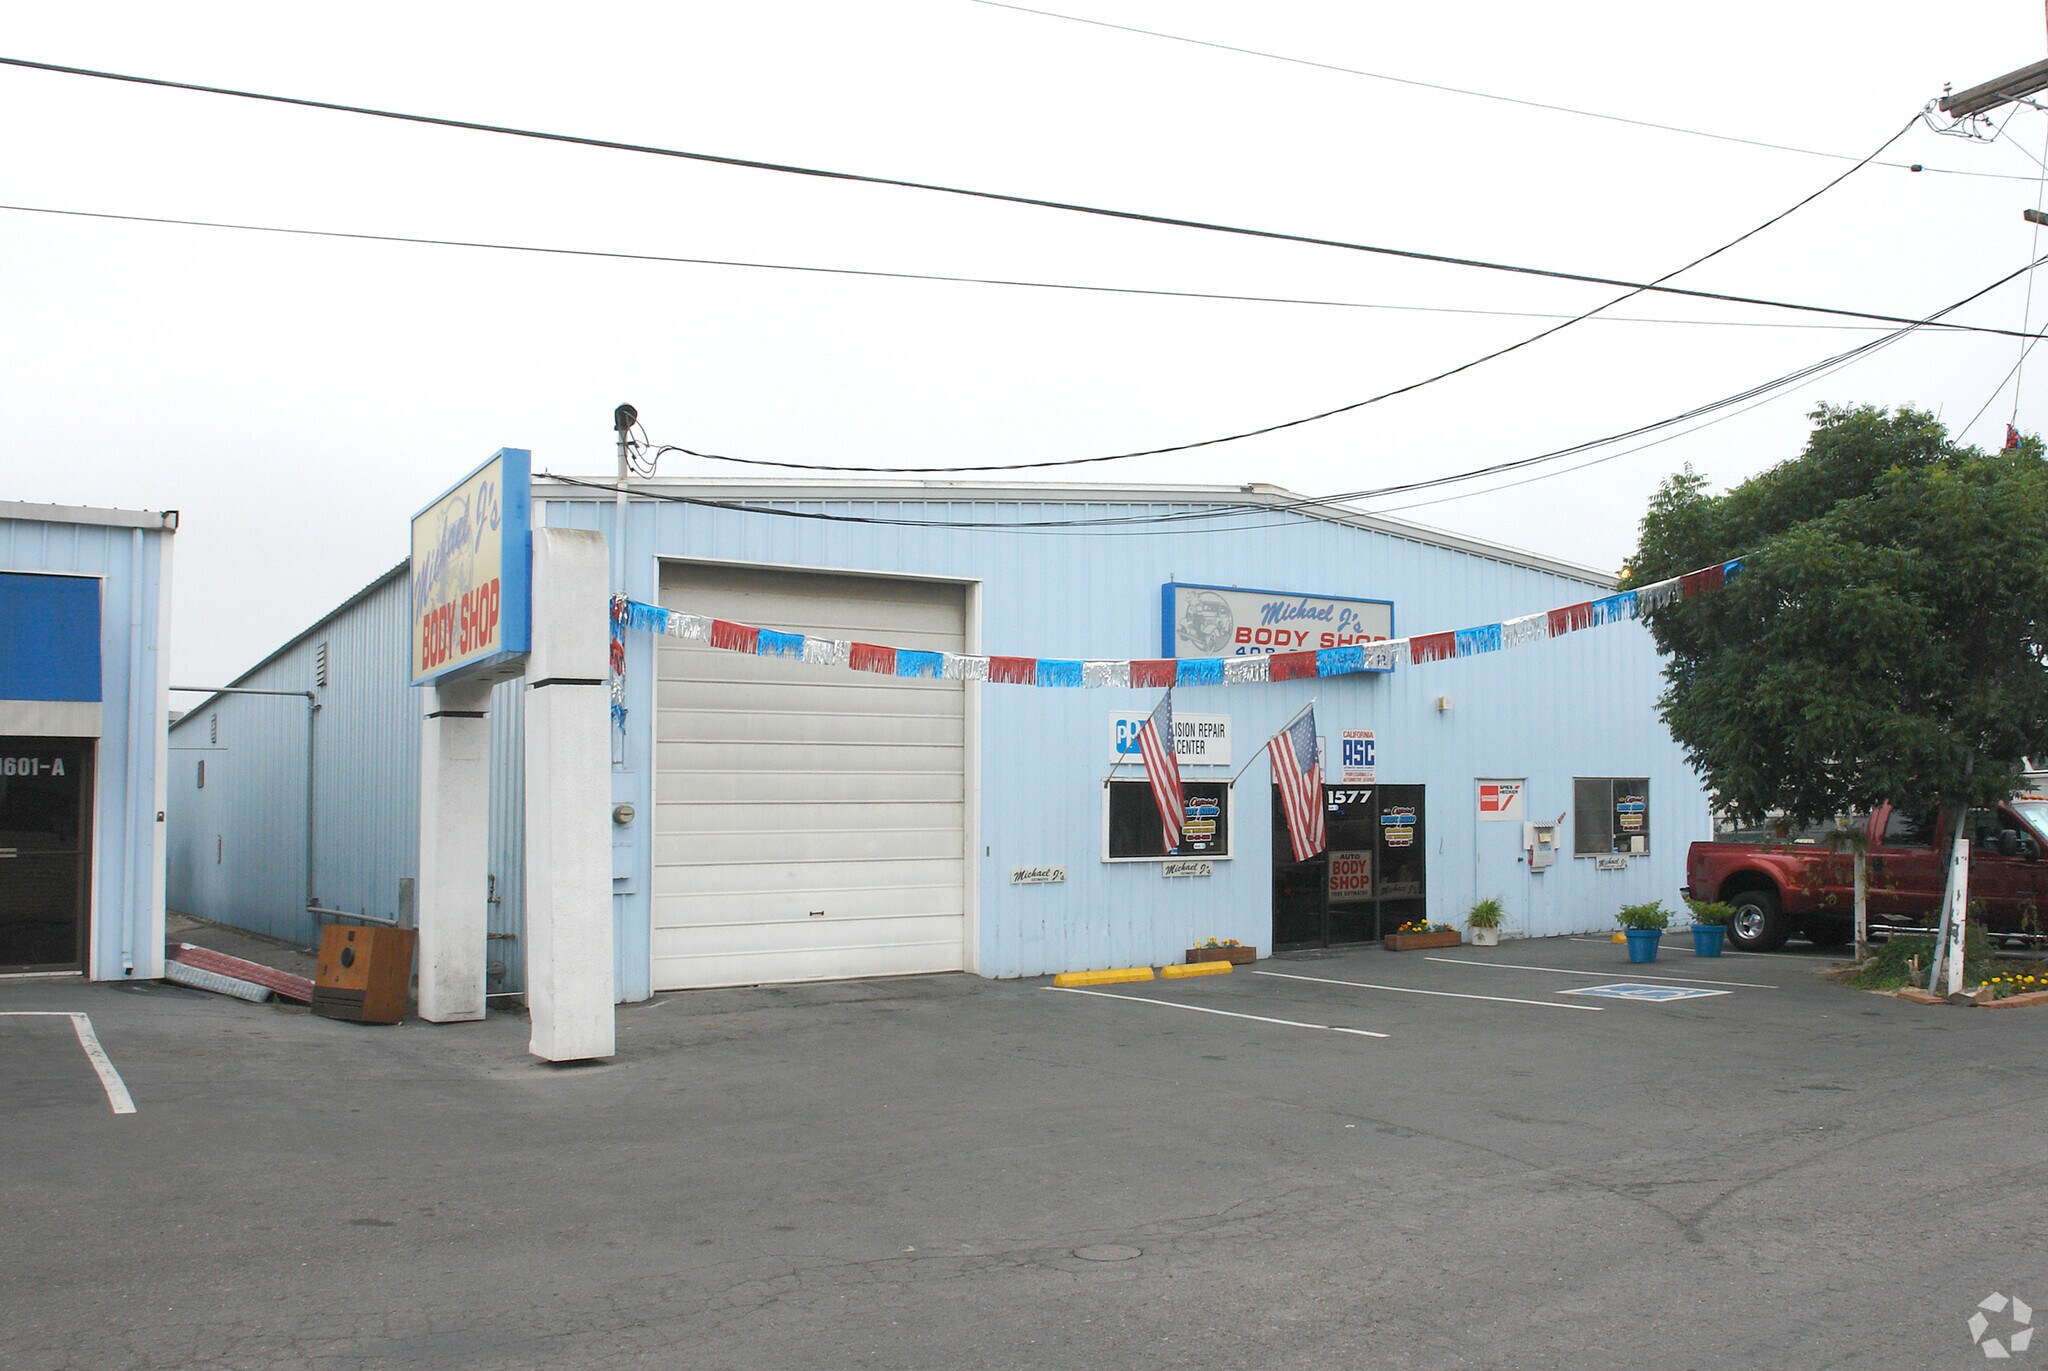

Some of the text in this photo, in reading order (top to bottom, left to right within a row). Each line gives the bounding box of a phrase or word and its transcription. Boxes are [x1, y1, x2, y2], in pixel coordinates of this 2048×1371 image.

[414, 480, 501, 625] Michael J's
[422, 577, 500, 671] BODY SHOP
[1261, 599, 1364, 634] Michael J's
[1235, 627, 1309, 647] BODY
[1199, 723, 1226, 738] REPAIR
[1177, 740, 1206, 755] CENTER
[1343, 740, 1375, 766] ASC
[1328, 790, 1372, 804] 1577
[1014, 868, 1065, 882] Michael J's
[1166, 862, 1211, 875] Michael J's
[1332, 860, 1367, 875] BODY
[1330, 875, 1370, 890] SHOP
